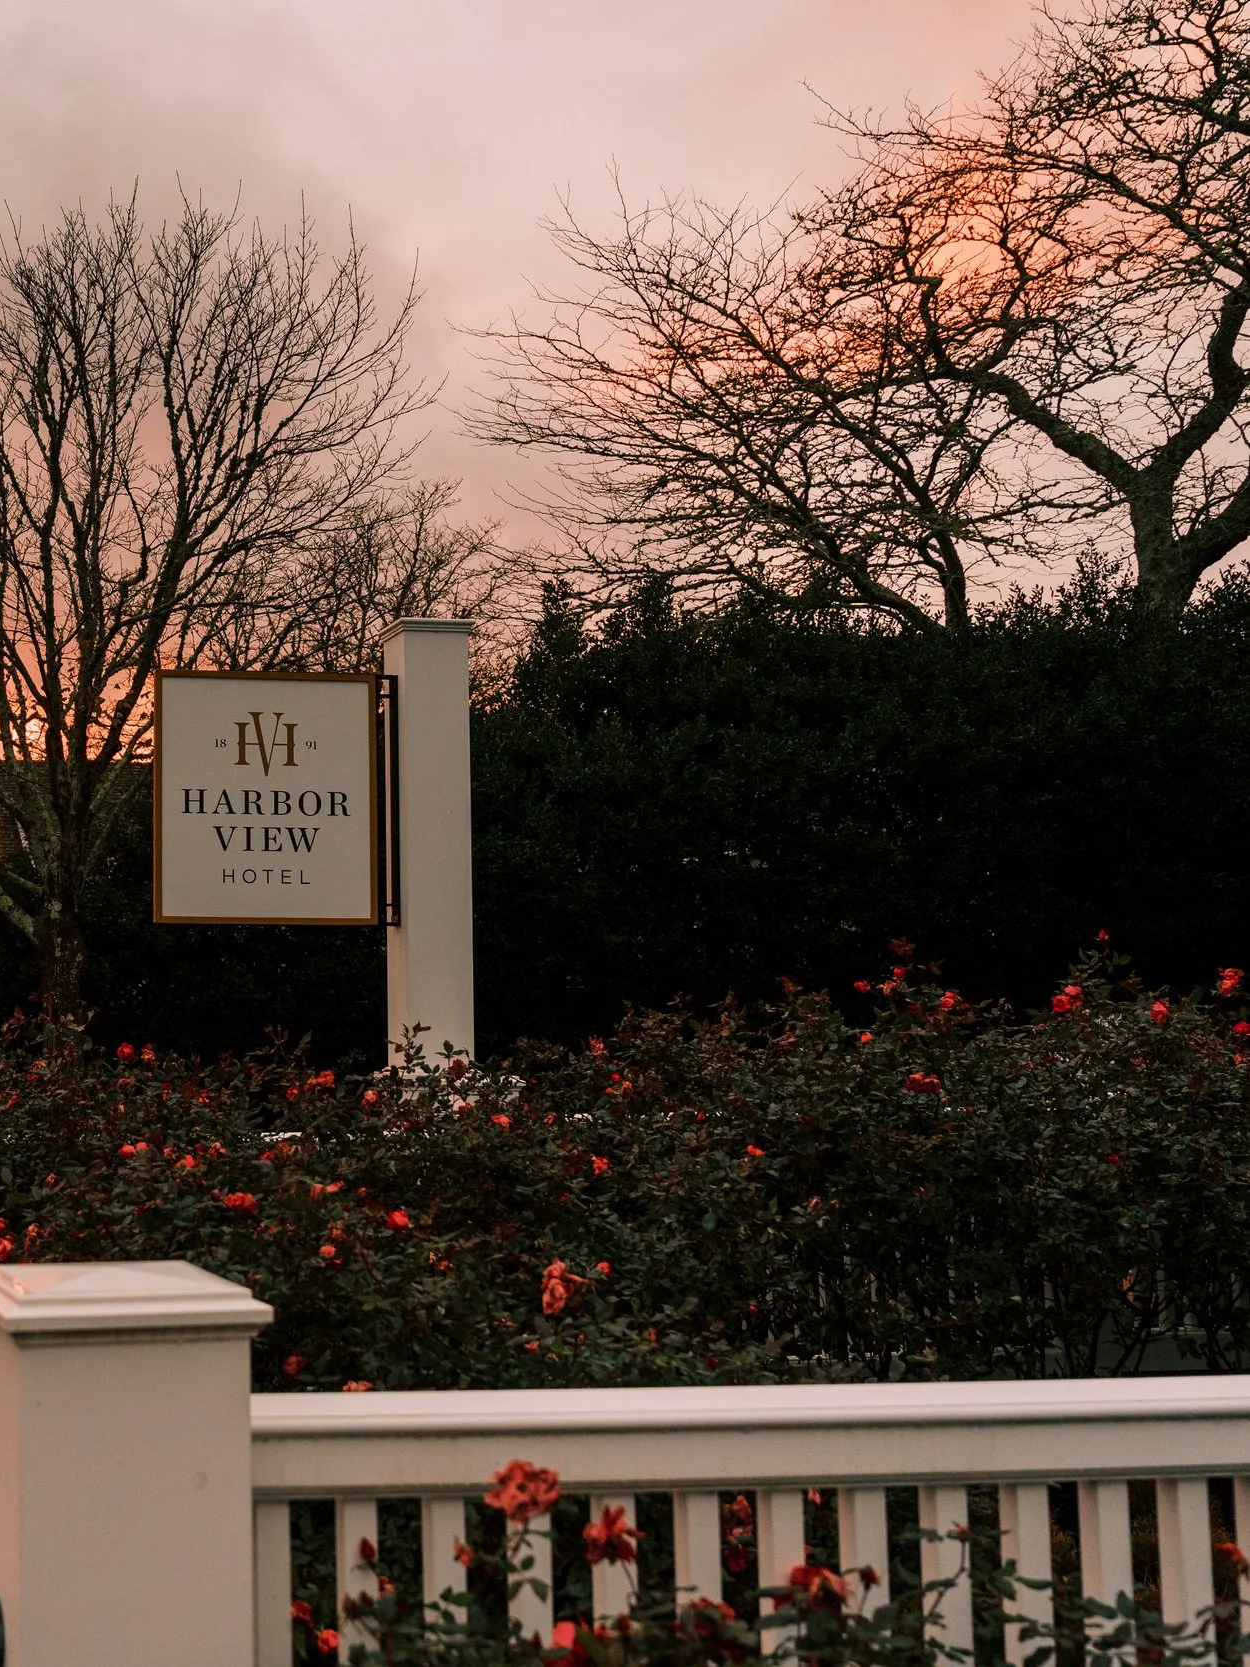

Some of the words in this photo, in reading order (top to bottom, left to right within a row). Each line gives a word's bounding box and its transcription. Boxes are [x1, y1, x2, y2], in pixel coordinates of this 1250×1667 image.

[214, 738, 227, 748] 18
[305, 740, 317, 750] 91
[181, 788, 351, 817] HARBOR
[212, 825, 321, 853] VIEW
[222, 868, 311, 885] HOTEL
